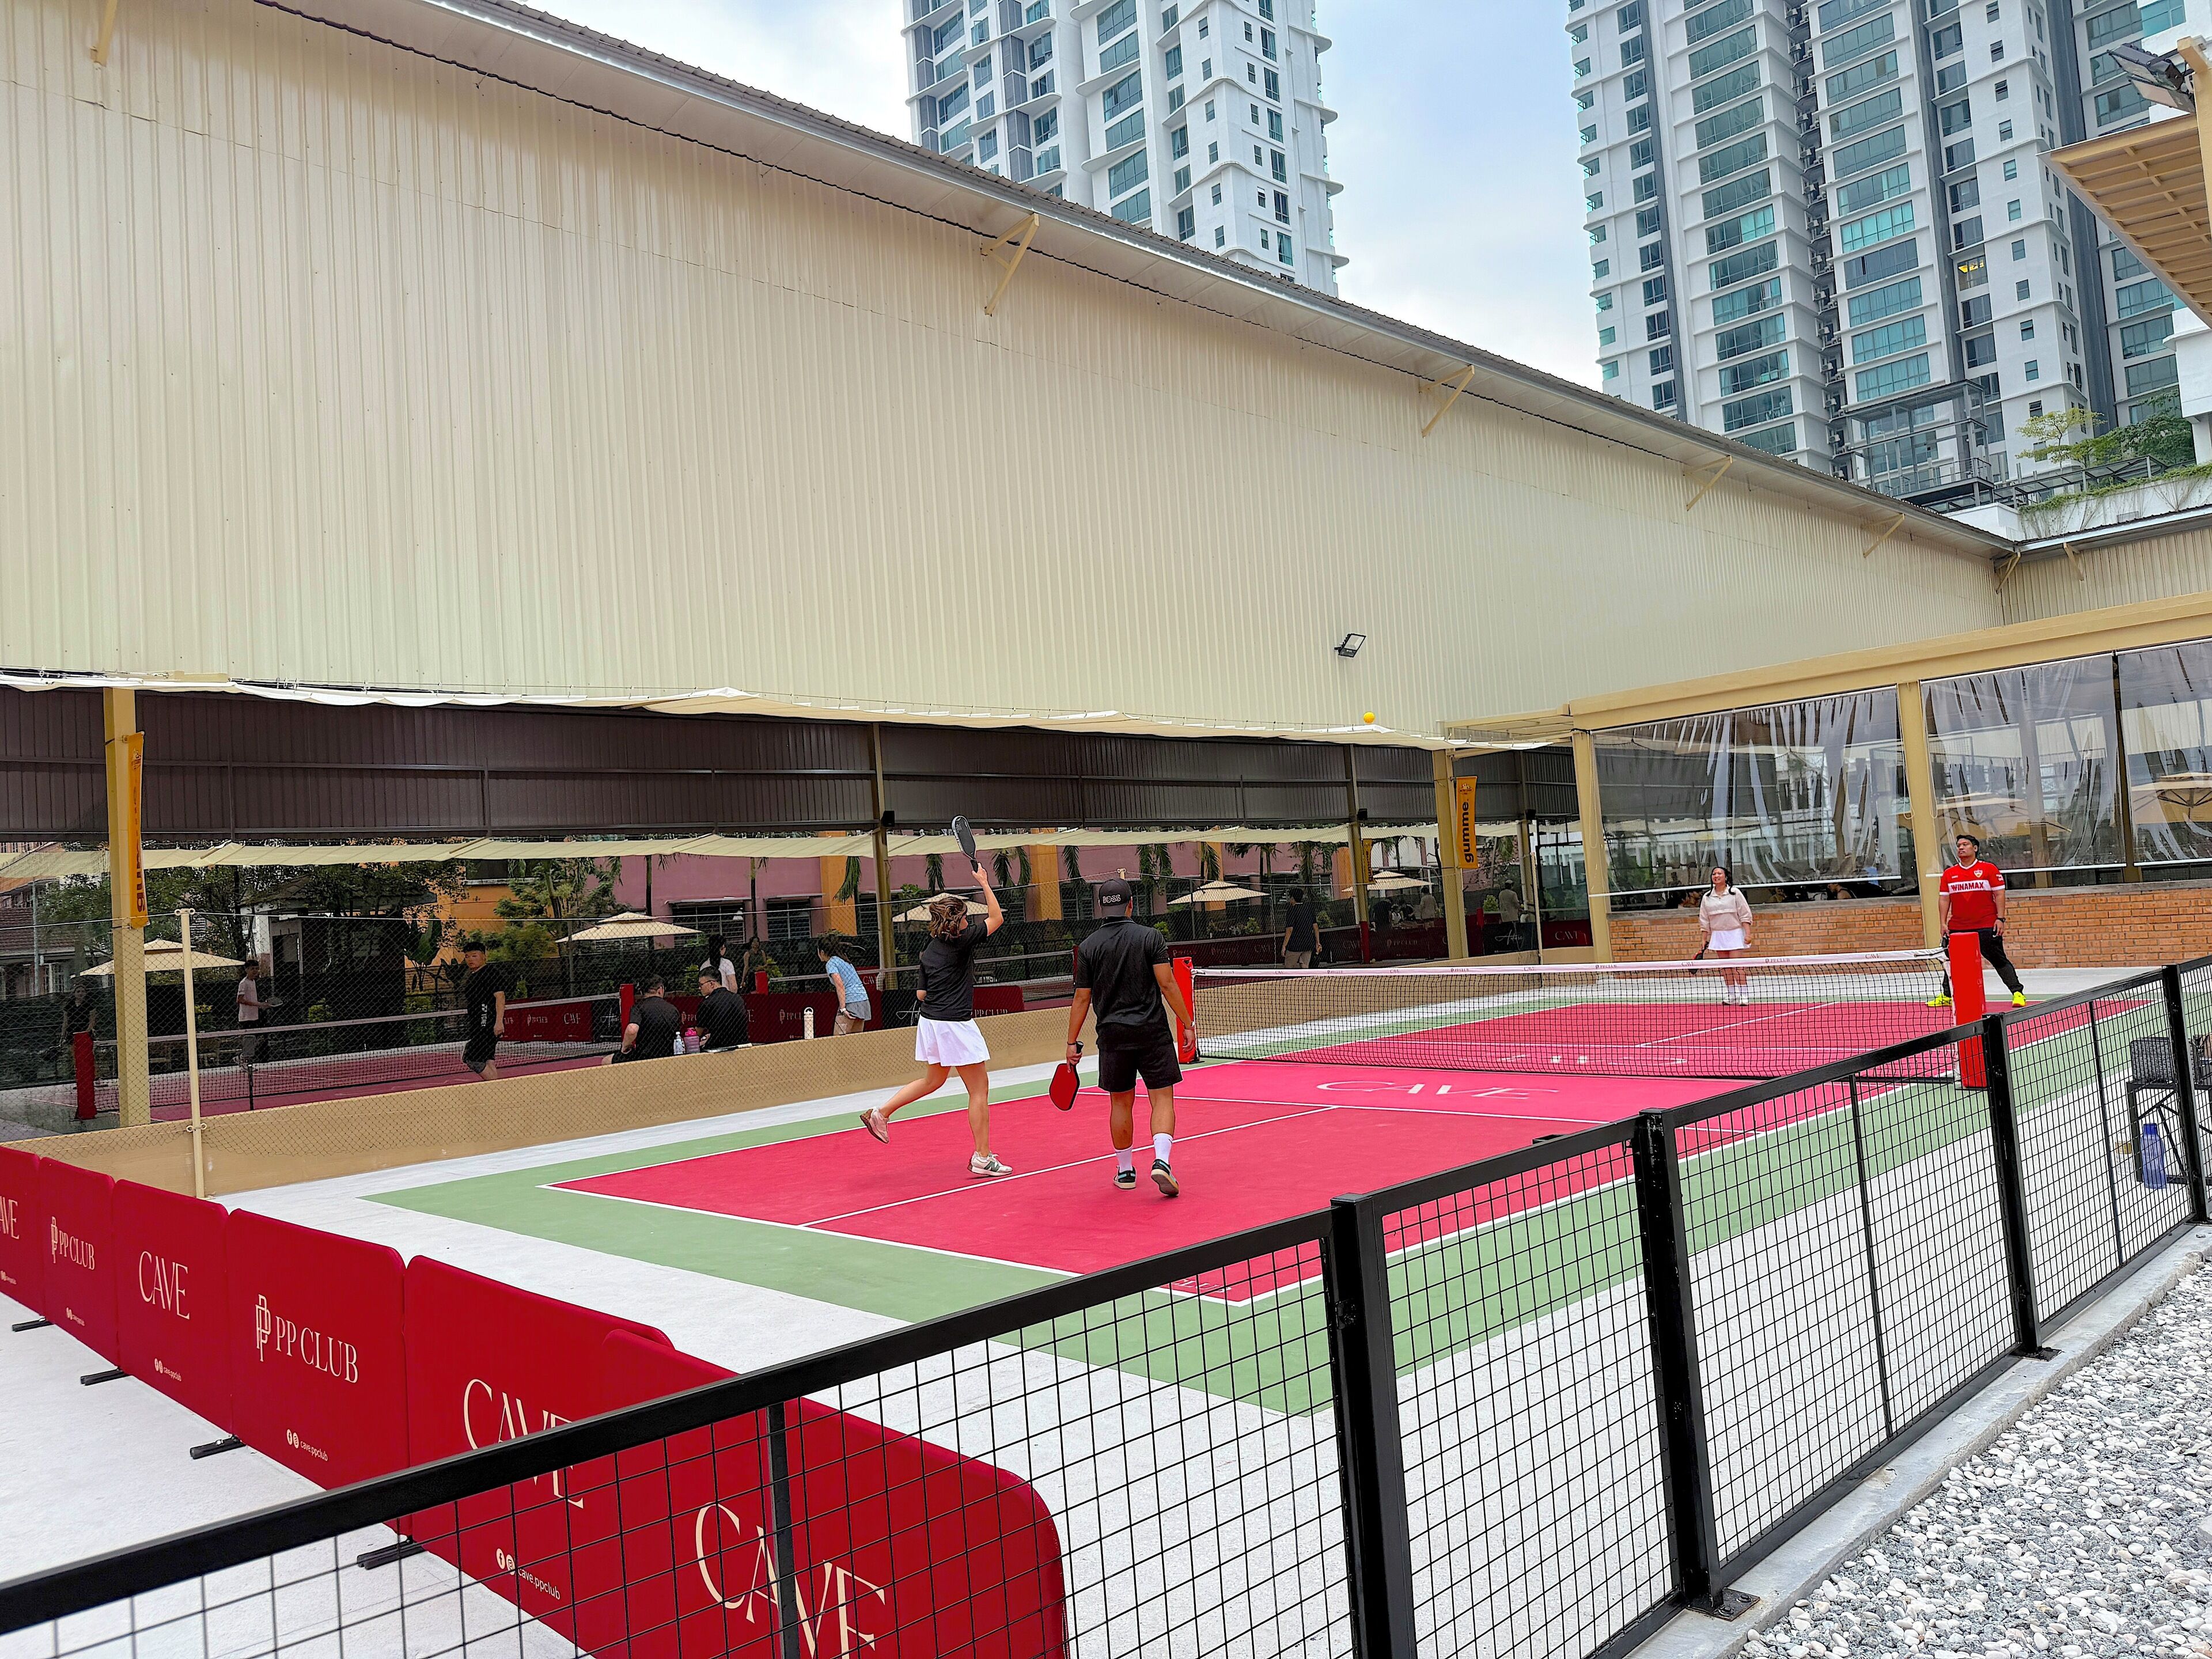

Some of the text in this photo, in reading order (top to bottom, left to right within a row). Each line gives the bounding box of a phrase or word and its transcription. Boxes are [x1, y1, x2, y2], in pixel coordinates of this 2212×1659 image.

[1103, 894, 1121, 904] BOSS
[1950, 881, 1984, 891] WINAMAX
[1317, 1081, 1559, 1100] CAVE
[0, 1196, 19, 1239] AVE
[59, 1230, 95, 1270] PP CLUB
[139, 1251, 190, 1320] CAVE
[275, 1316, 358, 1383] PP CLUB
[300, 1440, 328, 1461] cave.ppclub
[518, 1567, 560, 1600] cave.ppclub
[695, 1502, 885, 1659] CAVE
